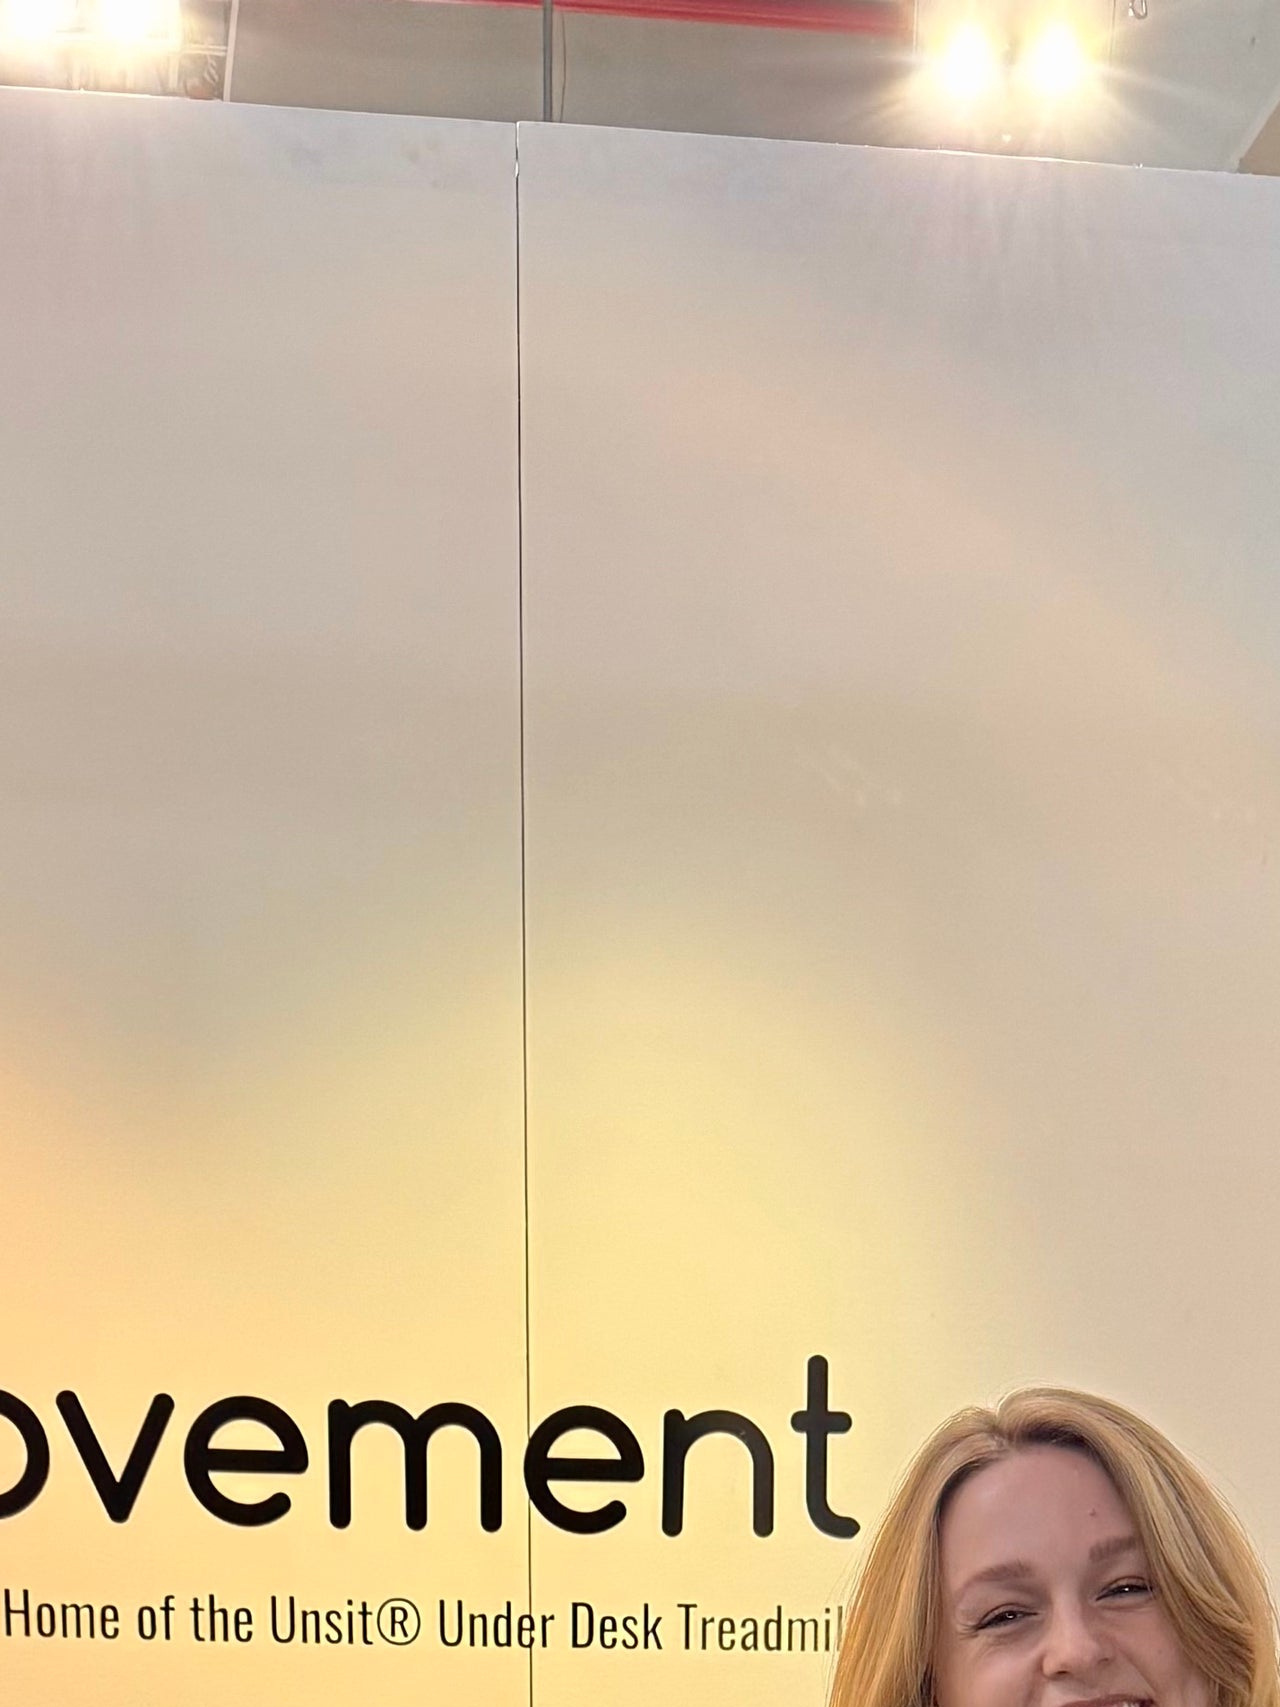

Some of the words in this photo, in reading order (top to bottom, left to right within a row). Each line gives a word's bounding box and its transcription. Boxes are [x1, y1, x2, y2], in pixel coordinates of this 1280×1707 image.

[5, 1588, 119, 1640] Home
[138, 1594, 176, 1641] of
[190, 1594, 253, 1643] the
[271, 1595, 421, 1647] Unsit®
[439, 1600, 554, 1649] Under
[572, 1602, 663, 1651] Desk
